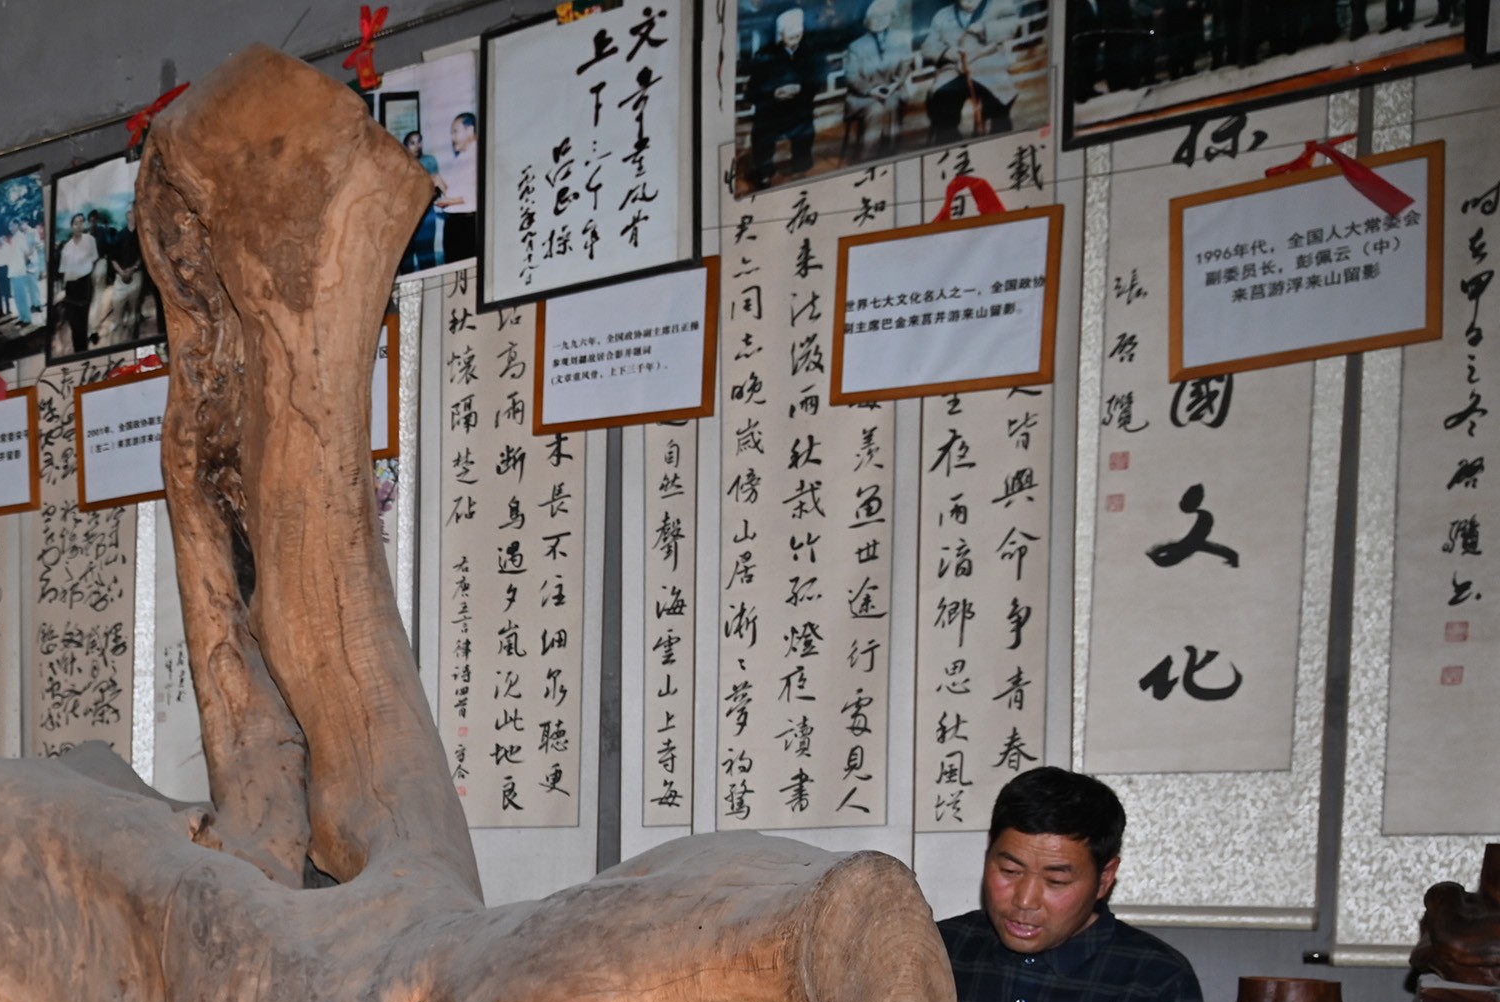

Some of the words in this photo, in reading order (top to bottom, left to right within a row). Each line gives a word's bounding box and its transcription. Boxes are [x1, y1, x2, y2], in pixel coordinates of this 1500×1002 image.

[1196, 209, 1422, 265] 1996年代，全国人大常委会
[1204, 236, 1402, 287] 副委员长，彭佩云（中）
[1231, 262, 1381, 303] 来莒游浮来山留影
